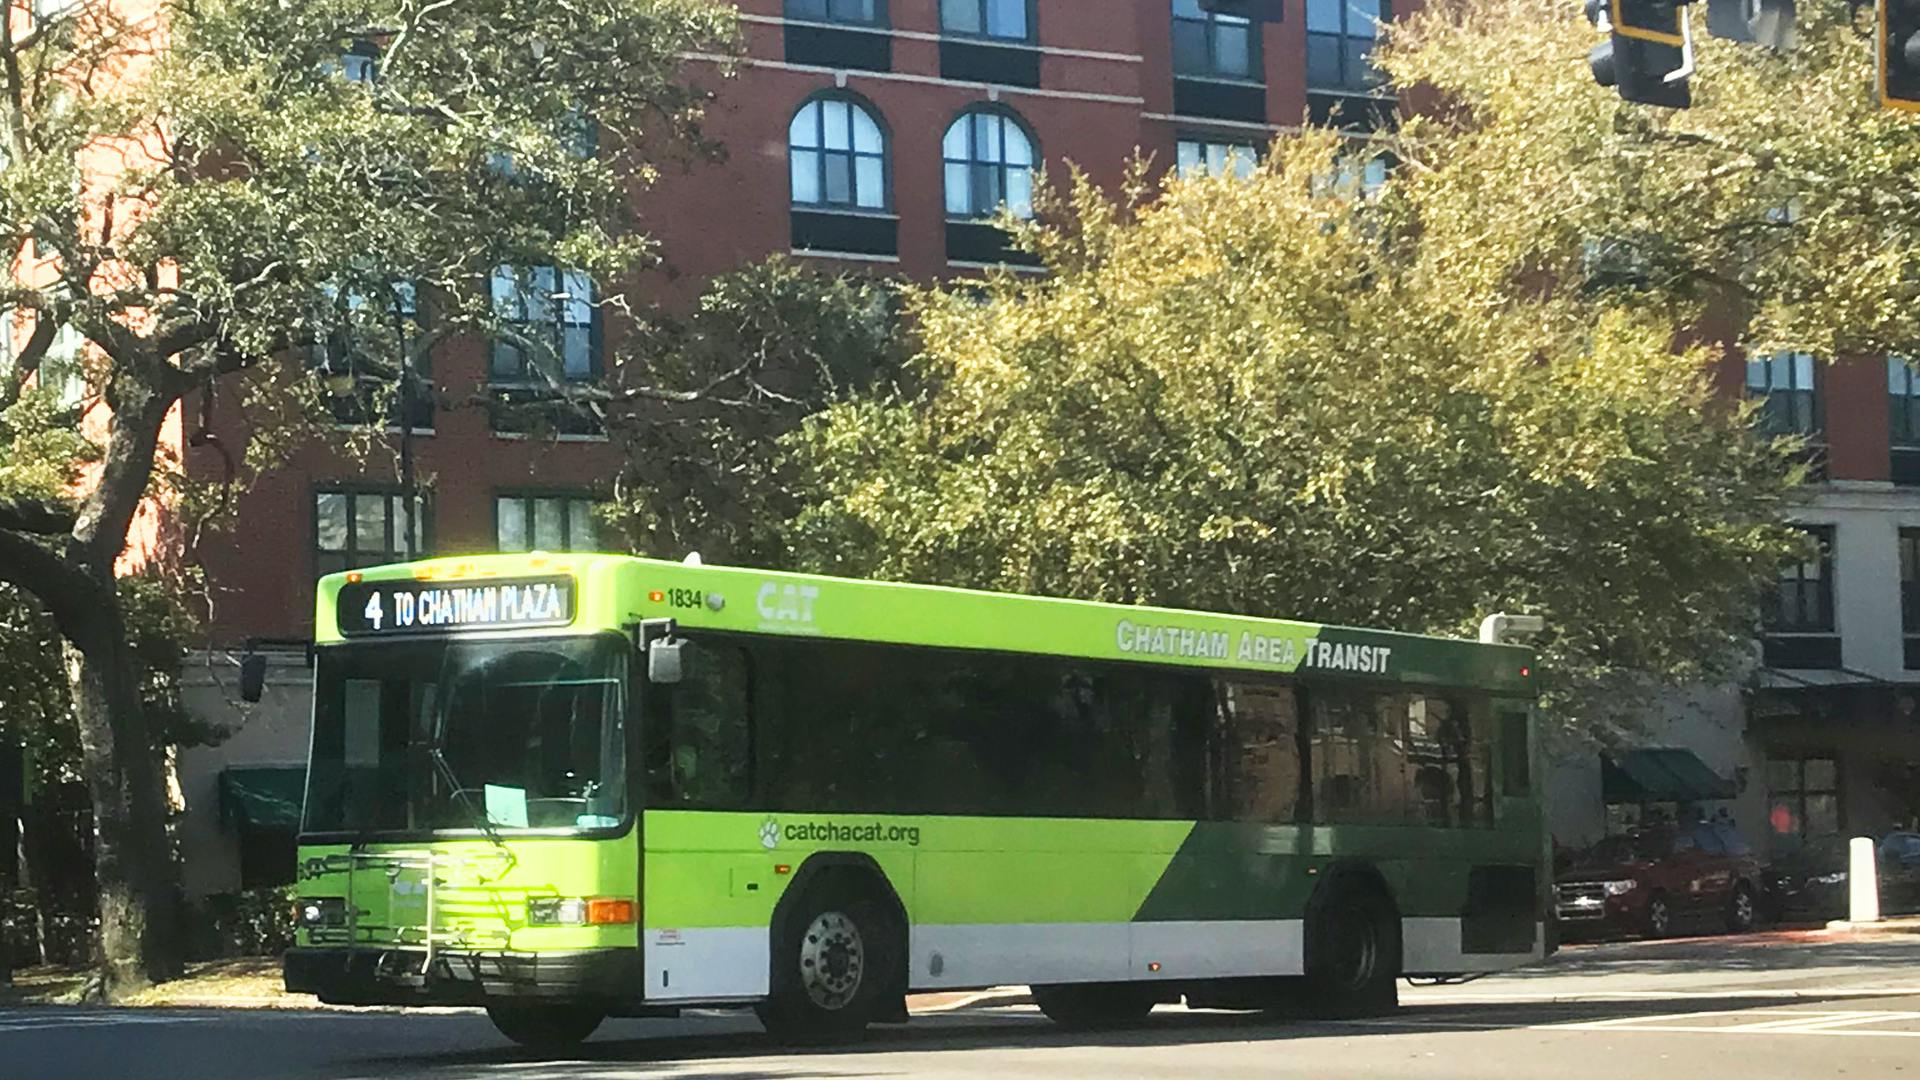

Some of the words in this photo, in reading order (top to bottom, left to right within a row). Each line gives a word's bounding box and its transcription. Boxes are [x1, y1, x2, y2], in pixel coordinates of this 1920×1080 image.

[365, 591, 384, 630] 4
[393, 592, 415, 626] TO
[418, 587, 497, 625] CHATHAM
[500, 584, 561, 621] PLAZA
[667, 588, 702, 609] 1834
[757, 581, 819, 622] CAT
[1116, 620, 1230, 659] CHATHAM
[1237, 631, 1297, 664] AREA
[1305, 638, 1391, 674] TRANSIT
[784, 821, 919, 846] catchacat.org
